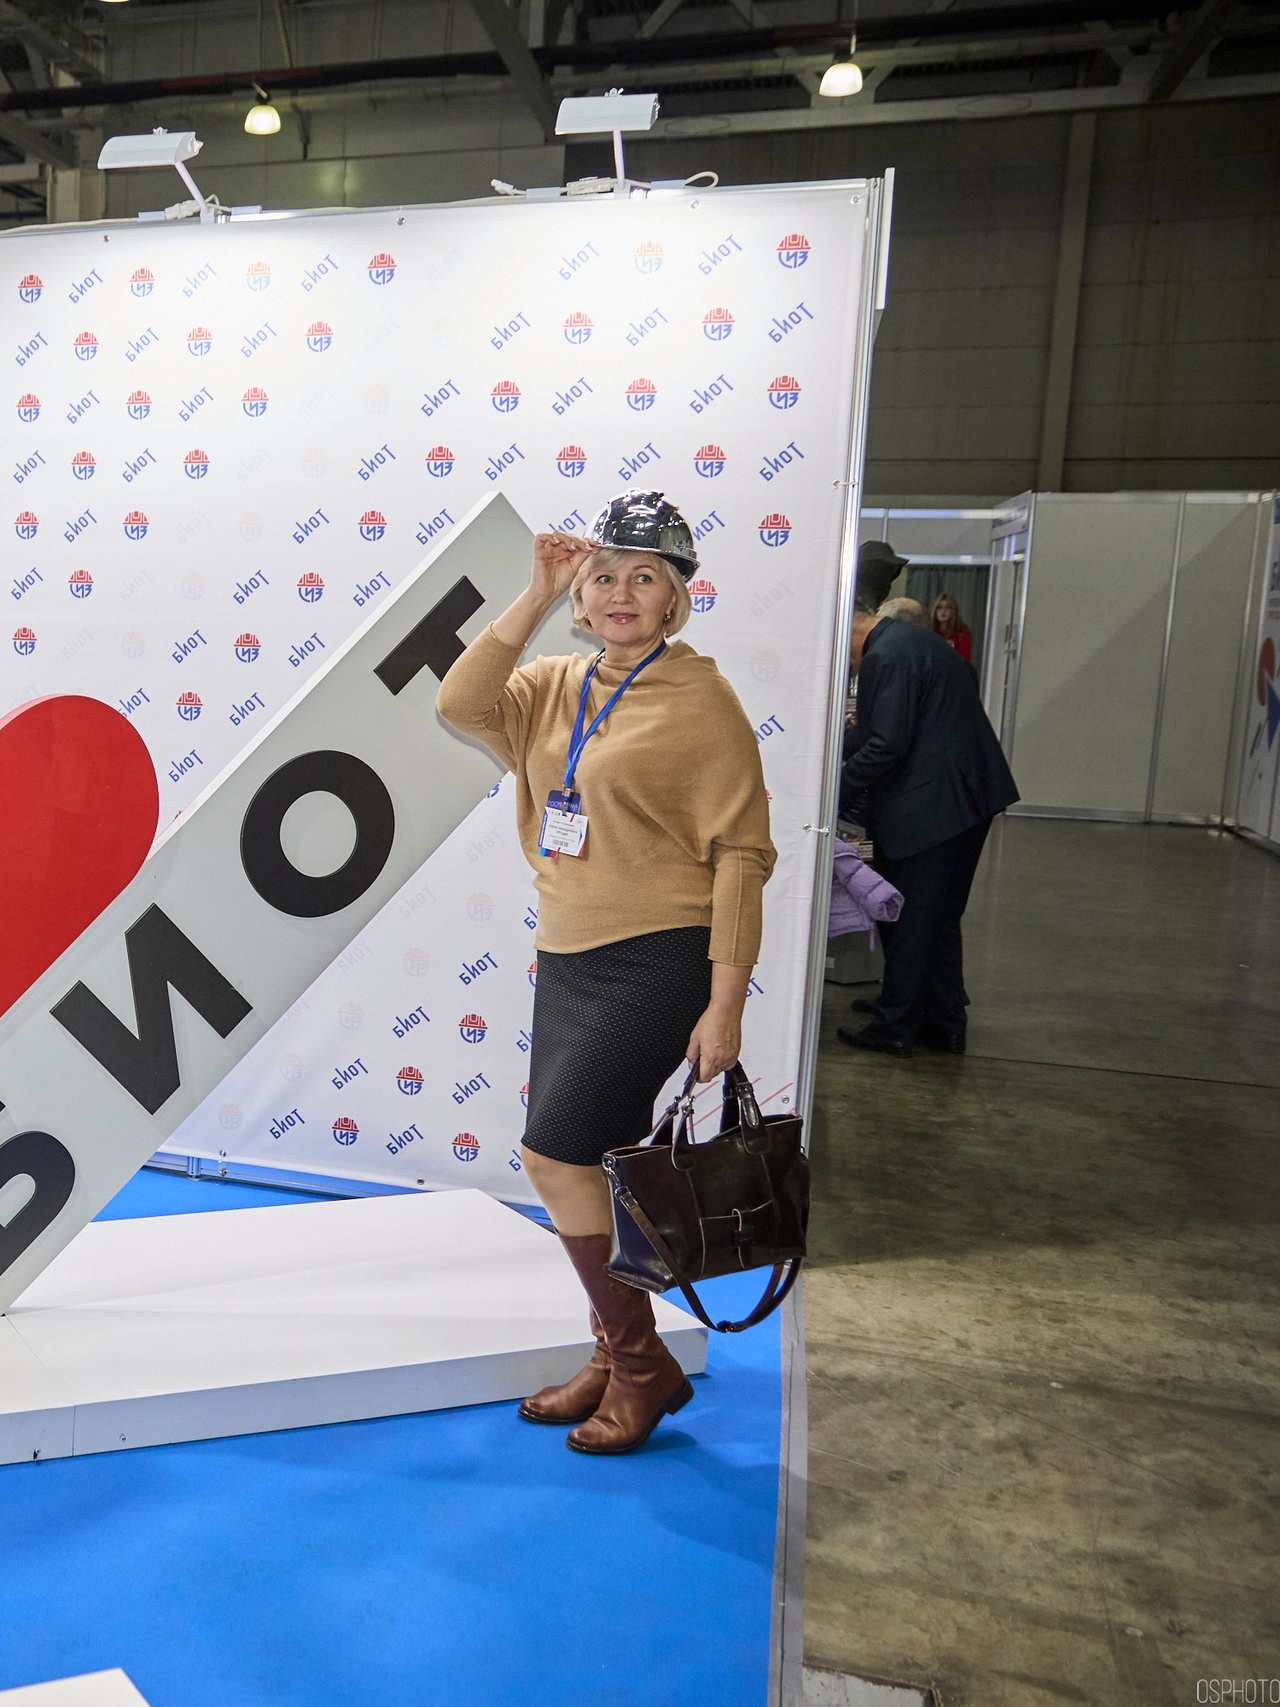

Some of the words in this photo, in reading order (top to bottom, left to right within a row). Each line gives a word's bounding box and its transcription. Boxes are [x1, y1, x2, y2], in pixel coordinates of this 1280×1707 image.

[699, 235, 742, 275] БИОТ
[68, 269, 103, 304] БИОТ
[301, 255, 339, 292] БИОТ
[241, 322, 277, 358] БИОТ
[490, 312, 531, 350] БИОТ
[767, 302, 814, 344] БИОТ
[15, 332, 48, 367] БИОТ
[66, 390, 100, 424] БИОТ
[178, 386, 214, 422] БИОТ
[420, 380, 461, 418] БИОТ
[551, 377, 594, 416] БИОТ
[689, 374, 734, 414] БИОТ
[13, 451, 45, 485] БИОТ
[122, 449, 157, 483] БИОТ
[357, 445, 396, 482] БИОТ
[484, 443, 525, 482] БИОТ
[618, 442, 661, 481] БИОТ
[758, 442, 805, 482] БИОТ
[63, 509, 98, 543] БИОТ
[292, 508, 330, 545] БИОТ
[415, 508, 455, 546] БИОТ
[10, 567, 44, 601] БИОТ
[232, 569, 270, 605] БИОТ
[352, 571, 391, 607] БИОТ
[171, 630, 208, 664] БИОТ
[287, 632, 326, 668] БИОТ
[229, 692, 266, 727] БИОТ
[168, 750, 204, 782] БИОТ
[458, 952, 498, 986] БИОТ
[392, 1005, 431, 1038] БИОТ
[332, 1058, 368, 1090] БИОТ
[452, 1072, 491, 1104] БИОТ
[269, 1108, 305, 1139] БИОТ
[385, 1123, 424, 1156] БИОТ
